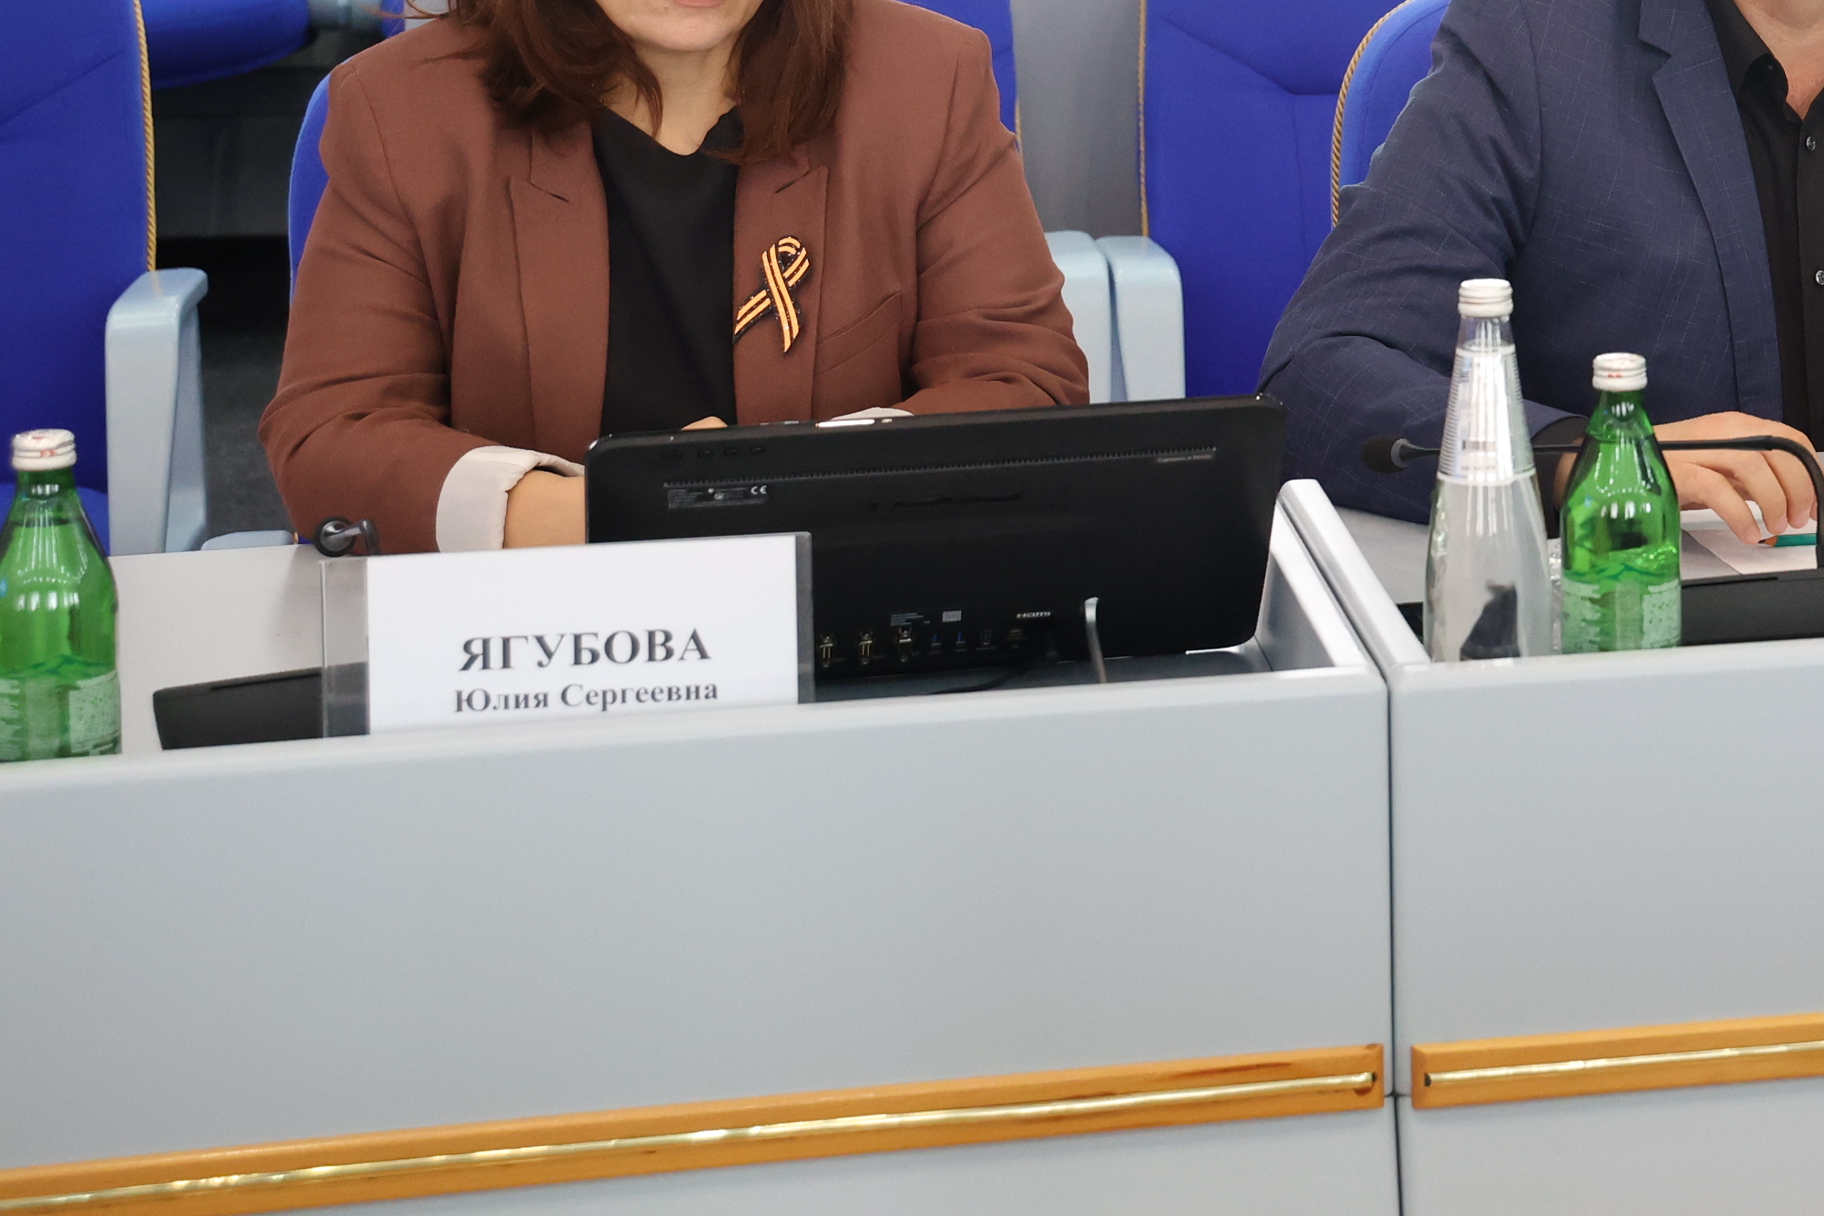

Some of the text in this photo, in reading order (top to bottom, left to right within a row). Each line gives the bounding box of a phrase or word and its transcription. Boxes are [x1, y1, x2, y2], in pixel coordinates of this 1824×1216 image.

[459, 627, 711, 672] ЯГУБОВА
[454, 682, 718, 714] Юлия Сергеевна
